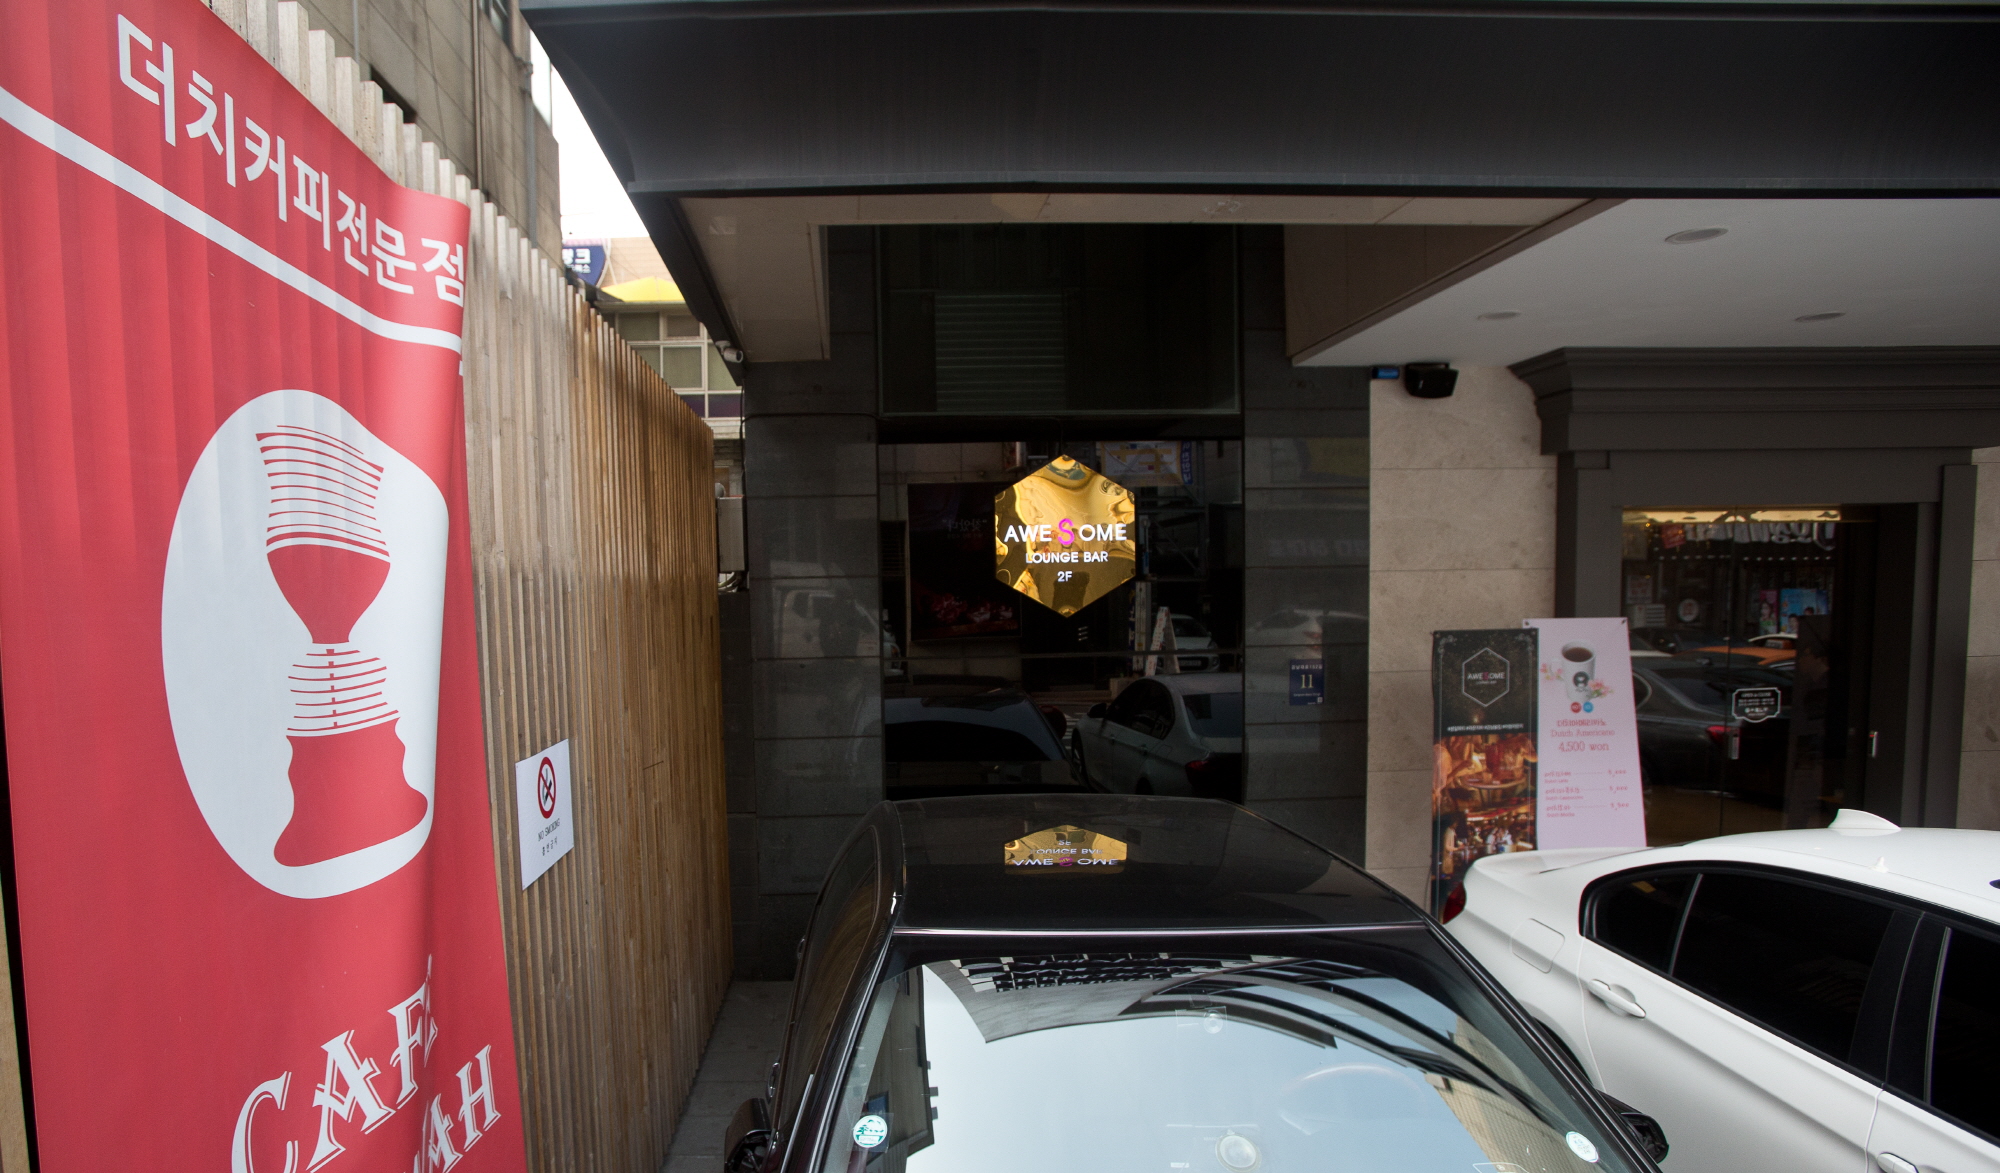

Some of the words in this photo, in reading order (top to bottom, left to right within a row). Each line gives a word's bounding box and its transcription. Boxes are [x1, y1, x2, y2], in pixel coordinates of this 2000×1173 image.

[117, 13, 465, 308] 더치커피전문점
[1004, 518, 1127, 545] AWESOME
[1025, 551, 1079, 564] LOUNGE
[1083, 551, 1109, 563] BAR
[1057, 571, 1073, 582] 2F
[1301, 674, 1314, 689] 11
[1467, 671, 1506, 681] AWESOME
[1551, 729, 1573, 738] Dutch
[1575, 729, 1616, 737] Americano
[1589, 743, 1610, 751] won
[538, 830, 544, 841] NO
[545, 818, 560, 836] SMOKING
